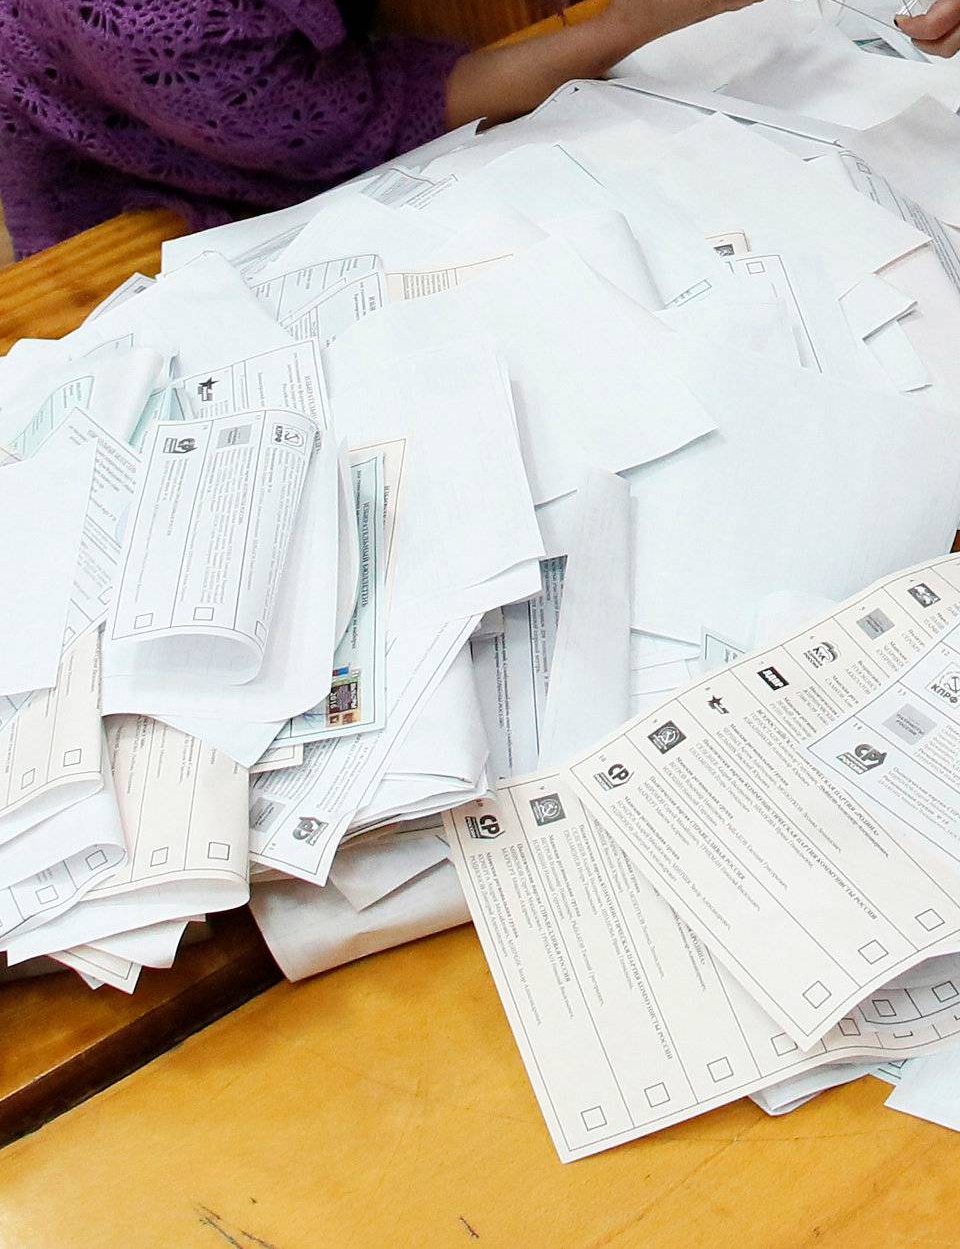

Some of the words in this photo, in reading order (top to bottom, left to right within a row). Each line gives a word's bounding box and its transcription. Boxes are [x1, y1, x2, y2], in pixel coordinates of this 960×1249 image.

[929, 681, 960, 706] КПРФ
[605, 759, 631, 785] СР
[477, 811, 501, 837] СР
